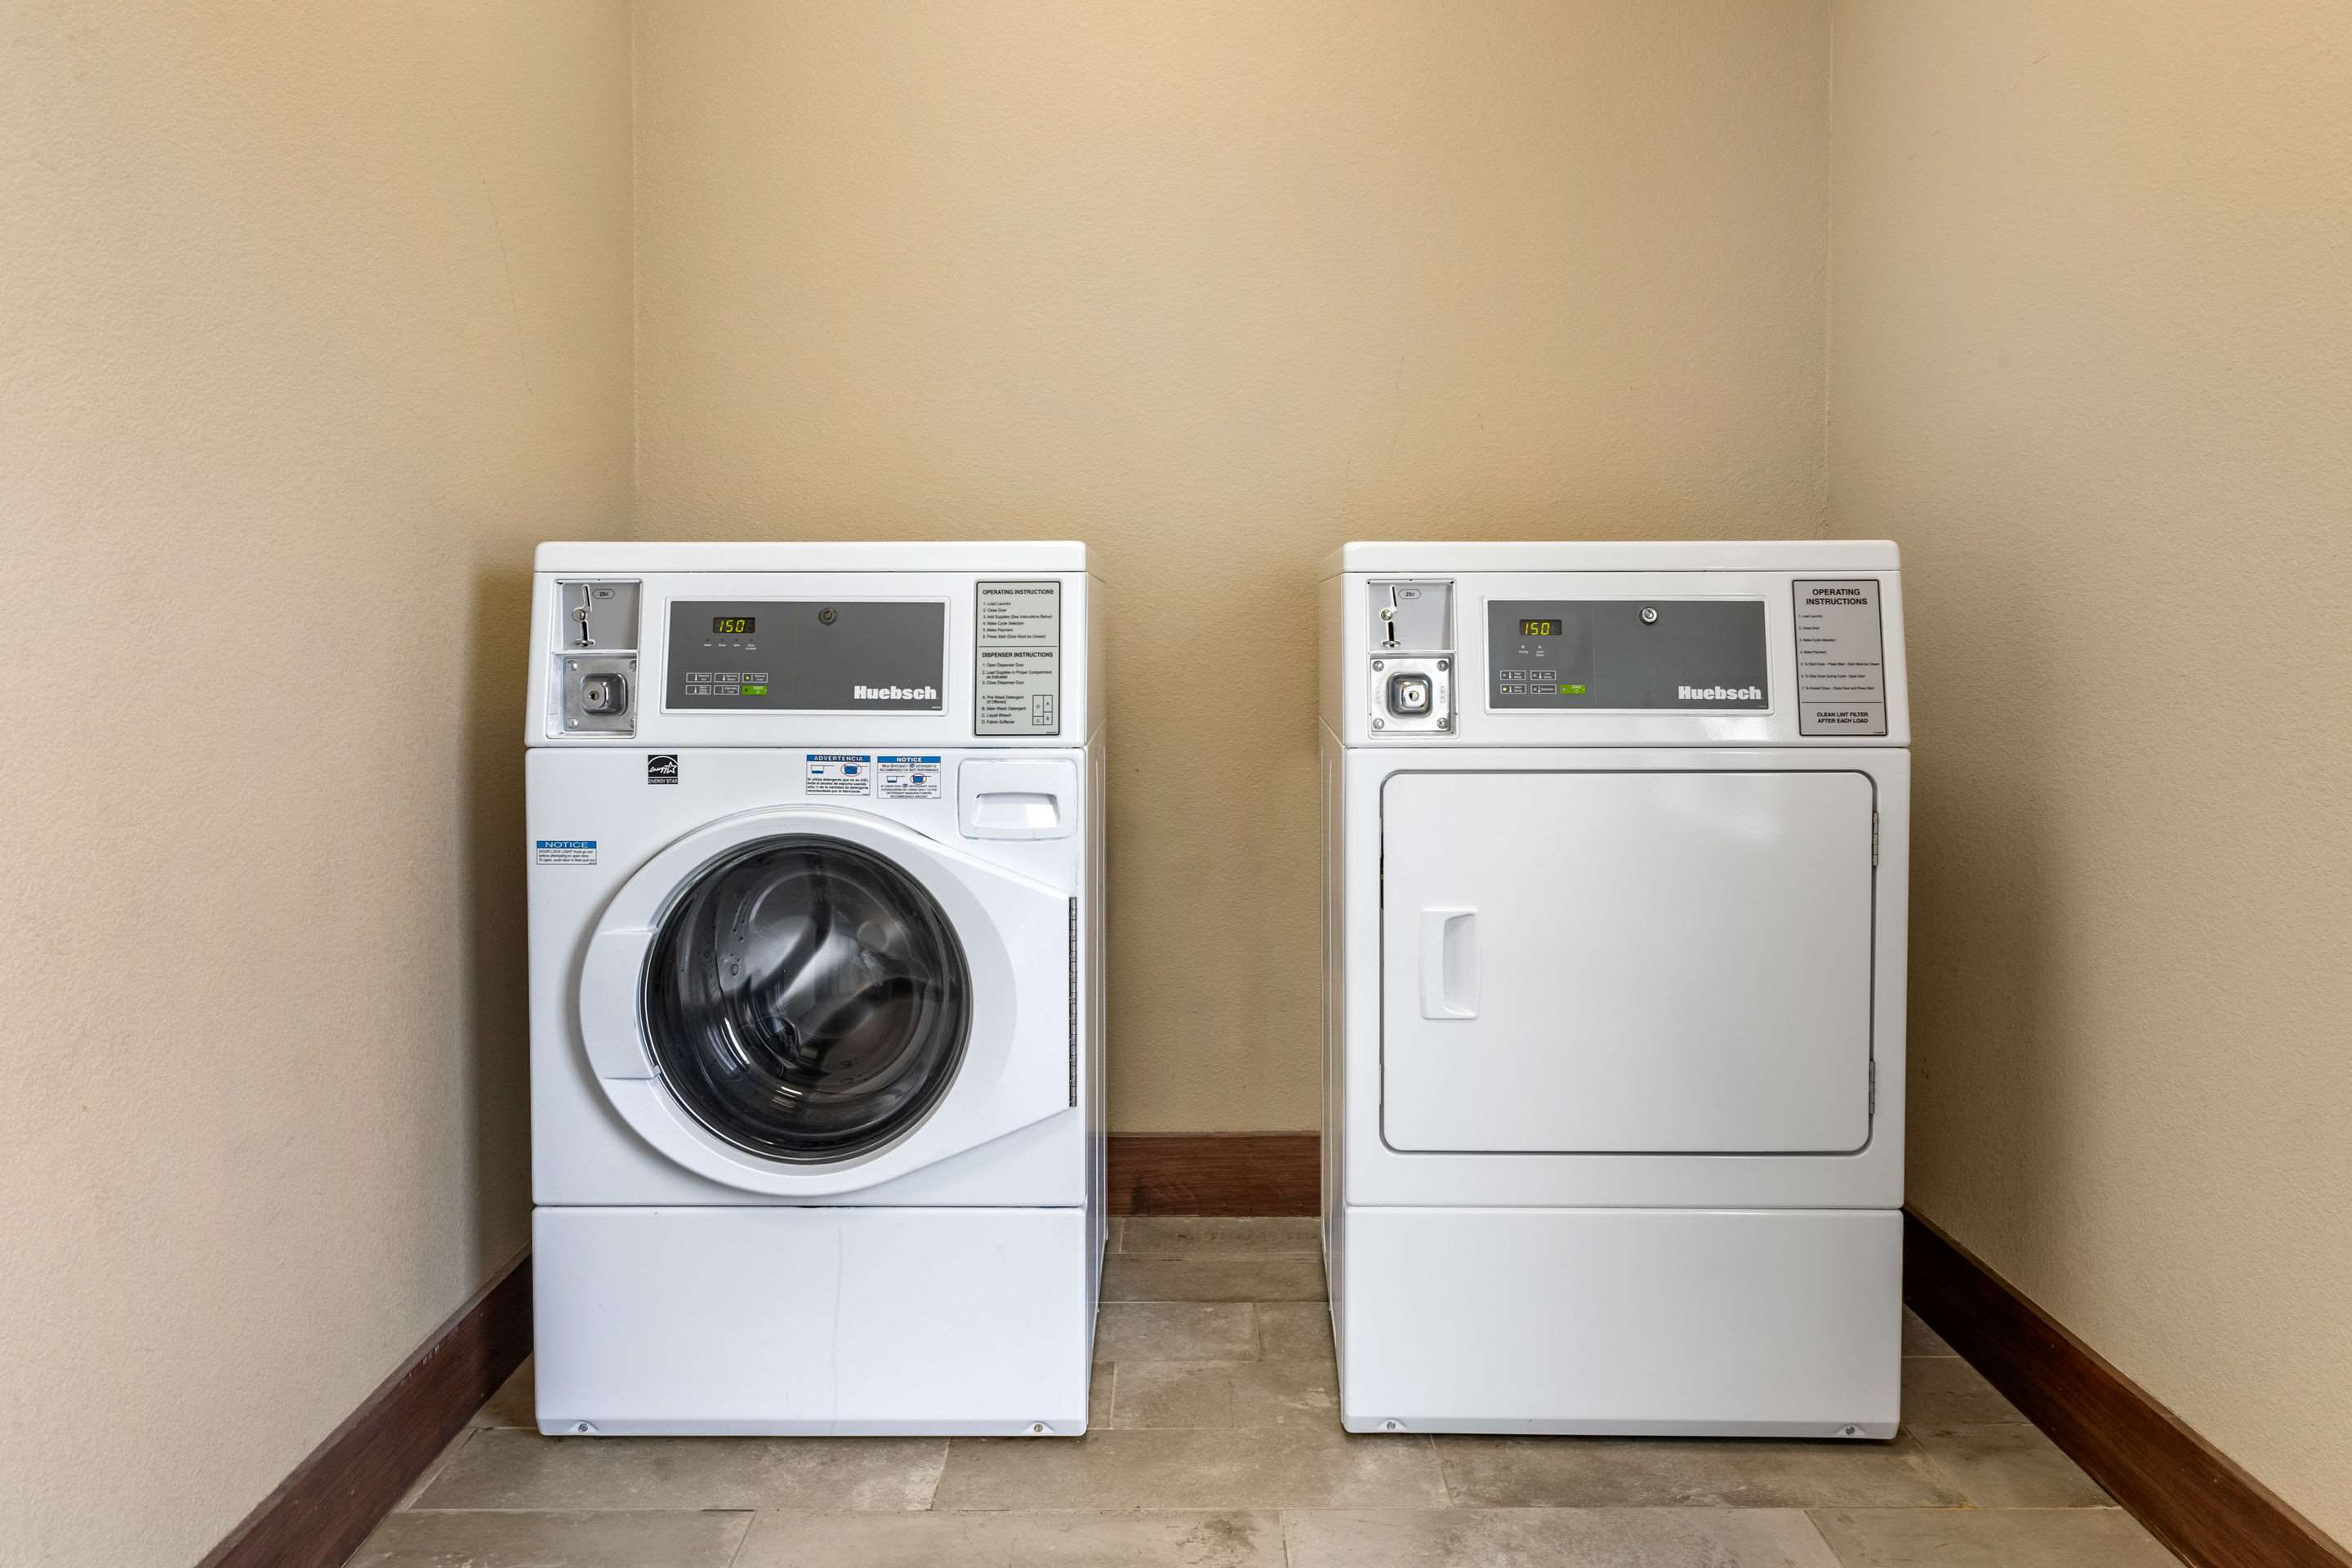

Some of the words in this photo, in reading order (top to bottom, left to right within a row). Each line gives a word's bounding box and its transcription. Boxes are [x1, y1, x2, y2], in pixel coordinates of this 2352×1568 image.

[719, 620, 745, 633] 150
[1525, 622, 1550, 635] 150
[854, 686, 937, 700] Huebsch
[1678, 686, 1762, 700] Huebsch
